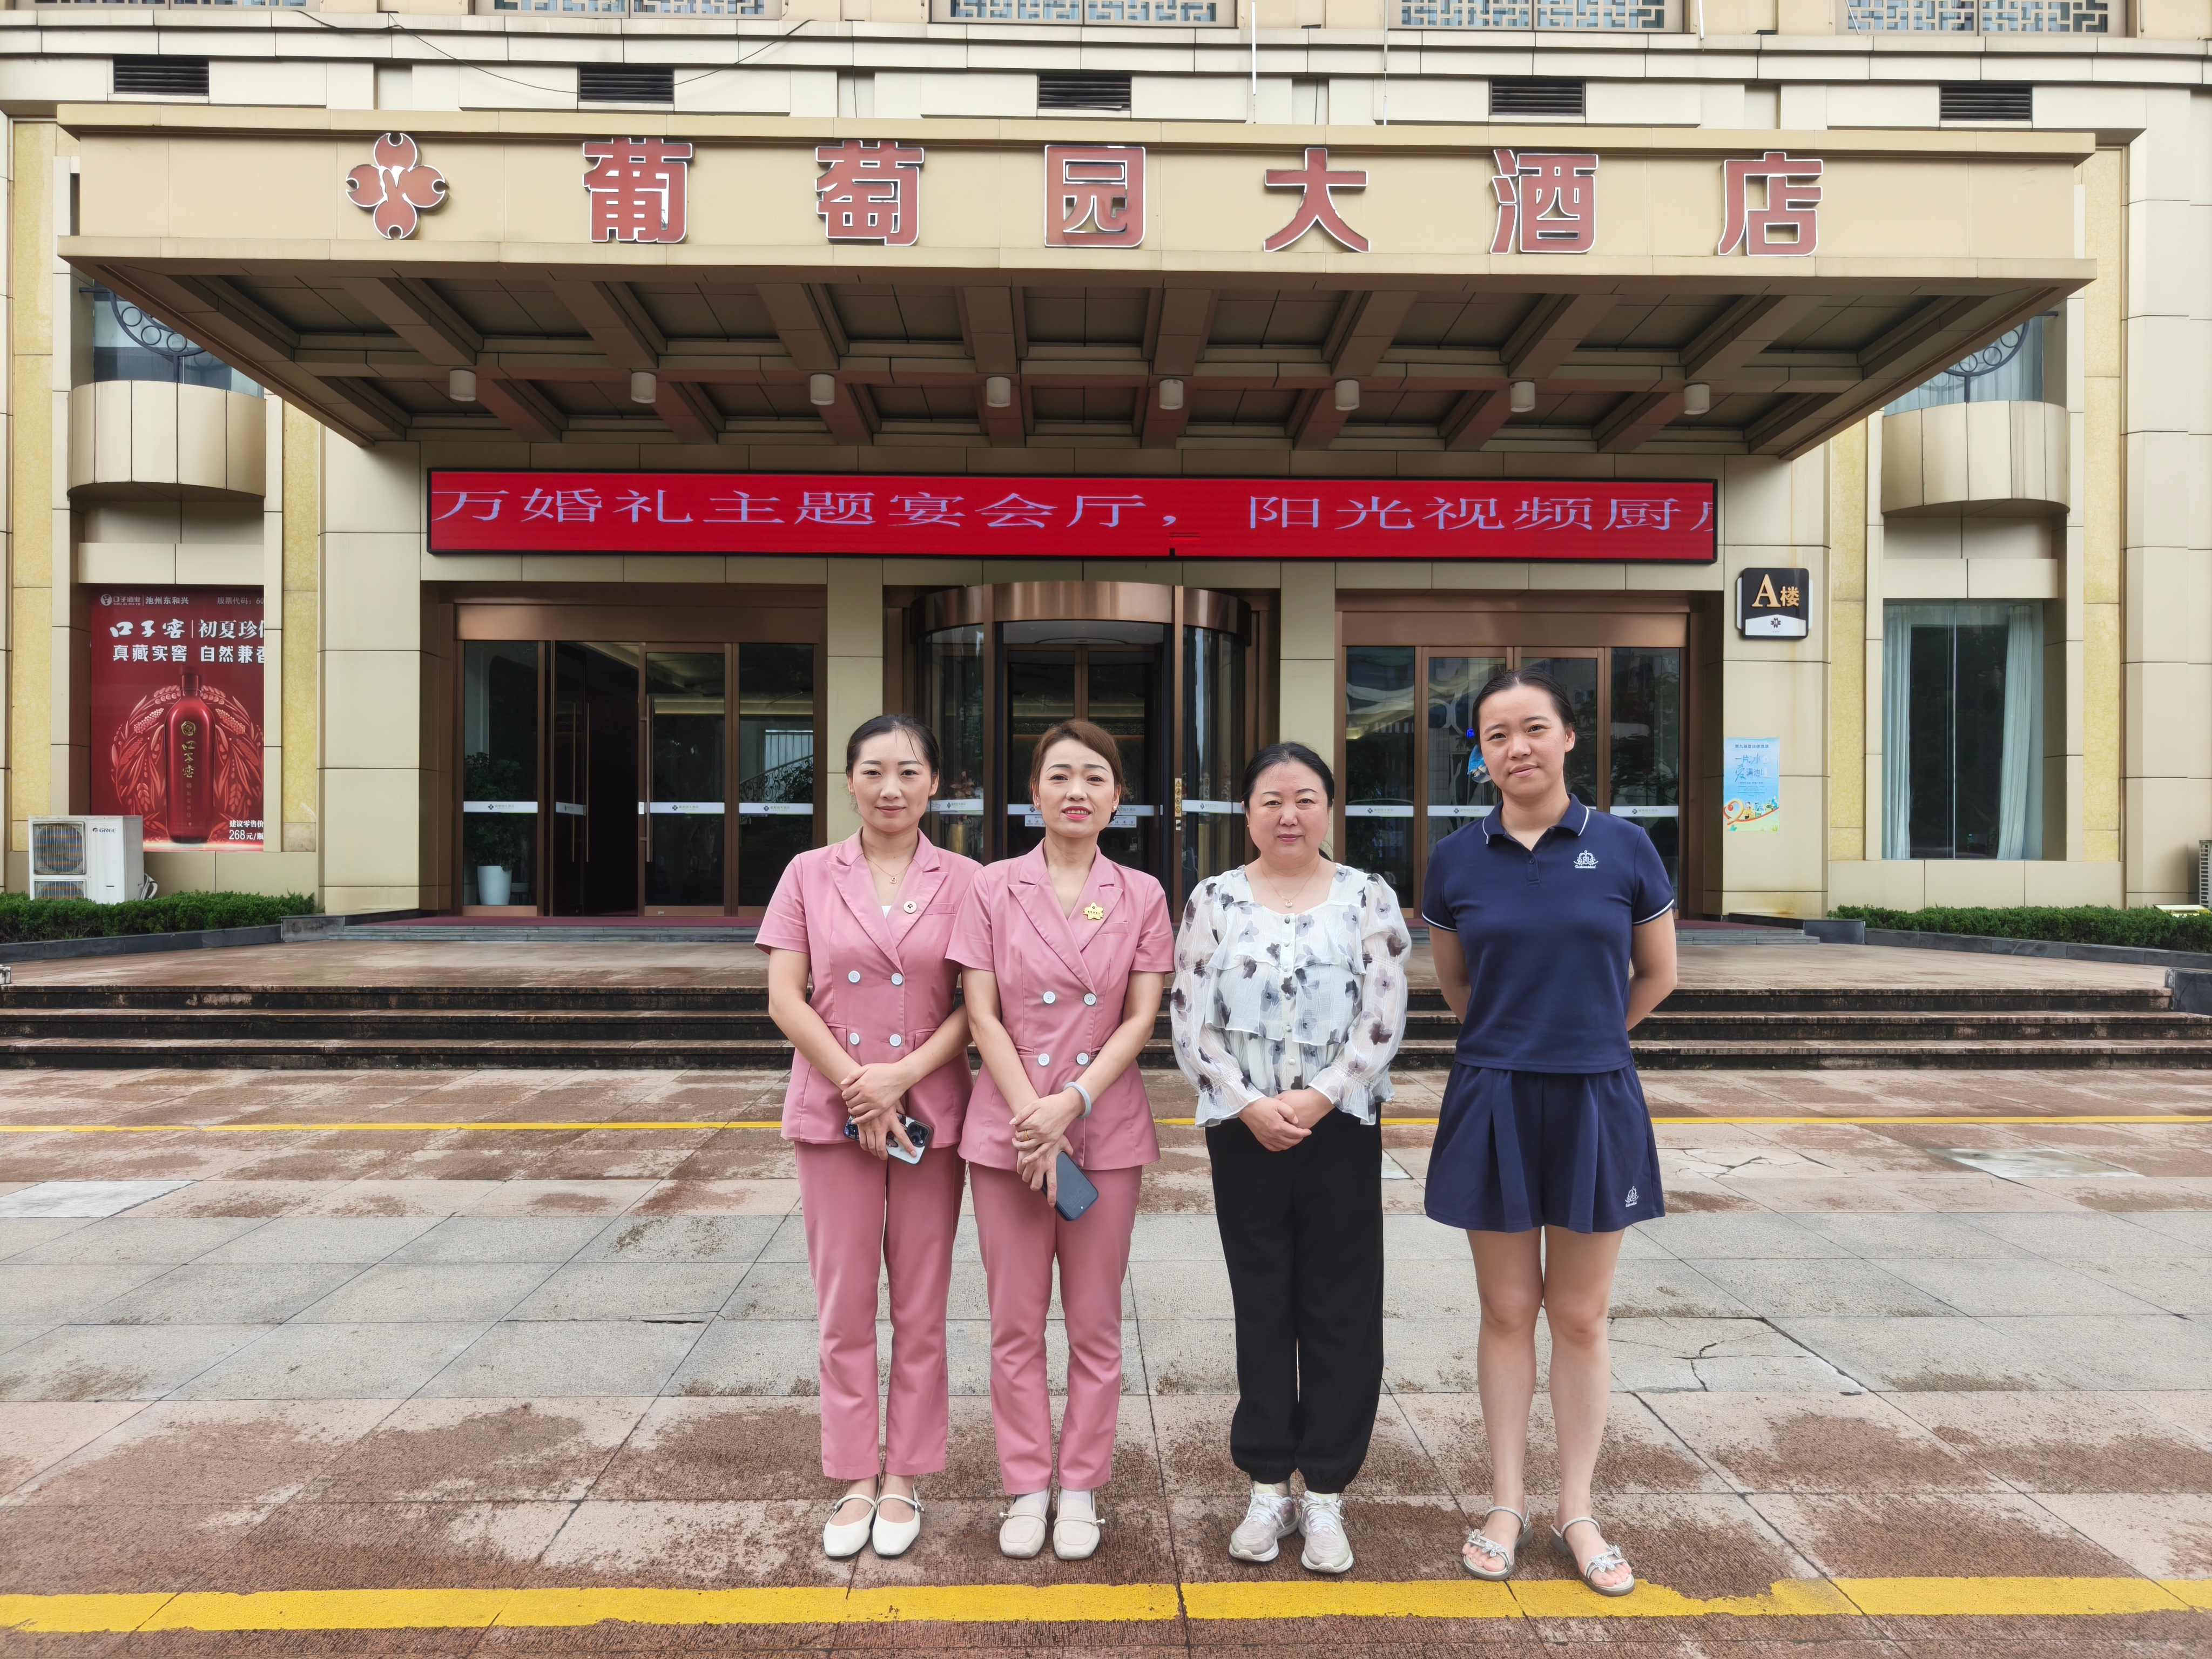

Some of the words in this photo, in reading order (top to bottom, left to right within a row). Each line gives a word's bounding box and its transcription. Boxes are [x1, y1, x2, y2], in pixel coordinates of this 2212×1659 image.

[582, 136, 1824, 257] 葡萄园大酒店
[145, 596, 189, 605] 池州东和兴
[1751, 574, 1799, 608] A楼
[110, 618, 185, 638] 口子窖
[113, 644, 187, 662] 真藏实窖
[229, 819, 264, 828] 建议零售价
